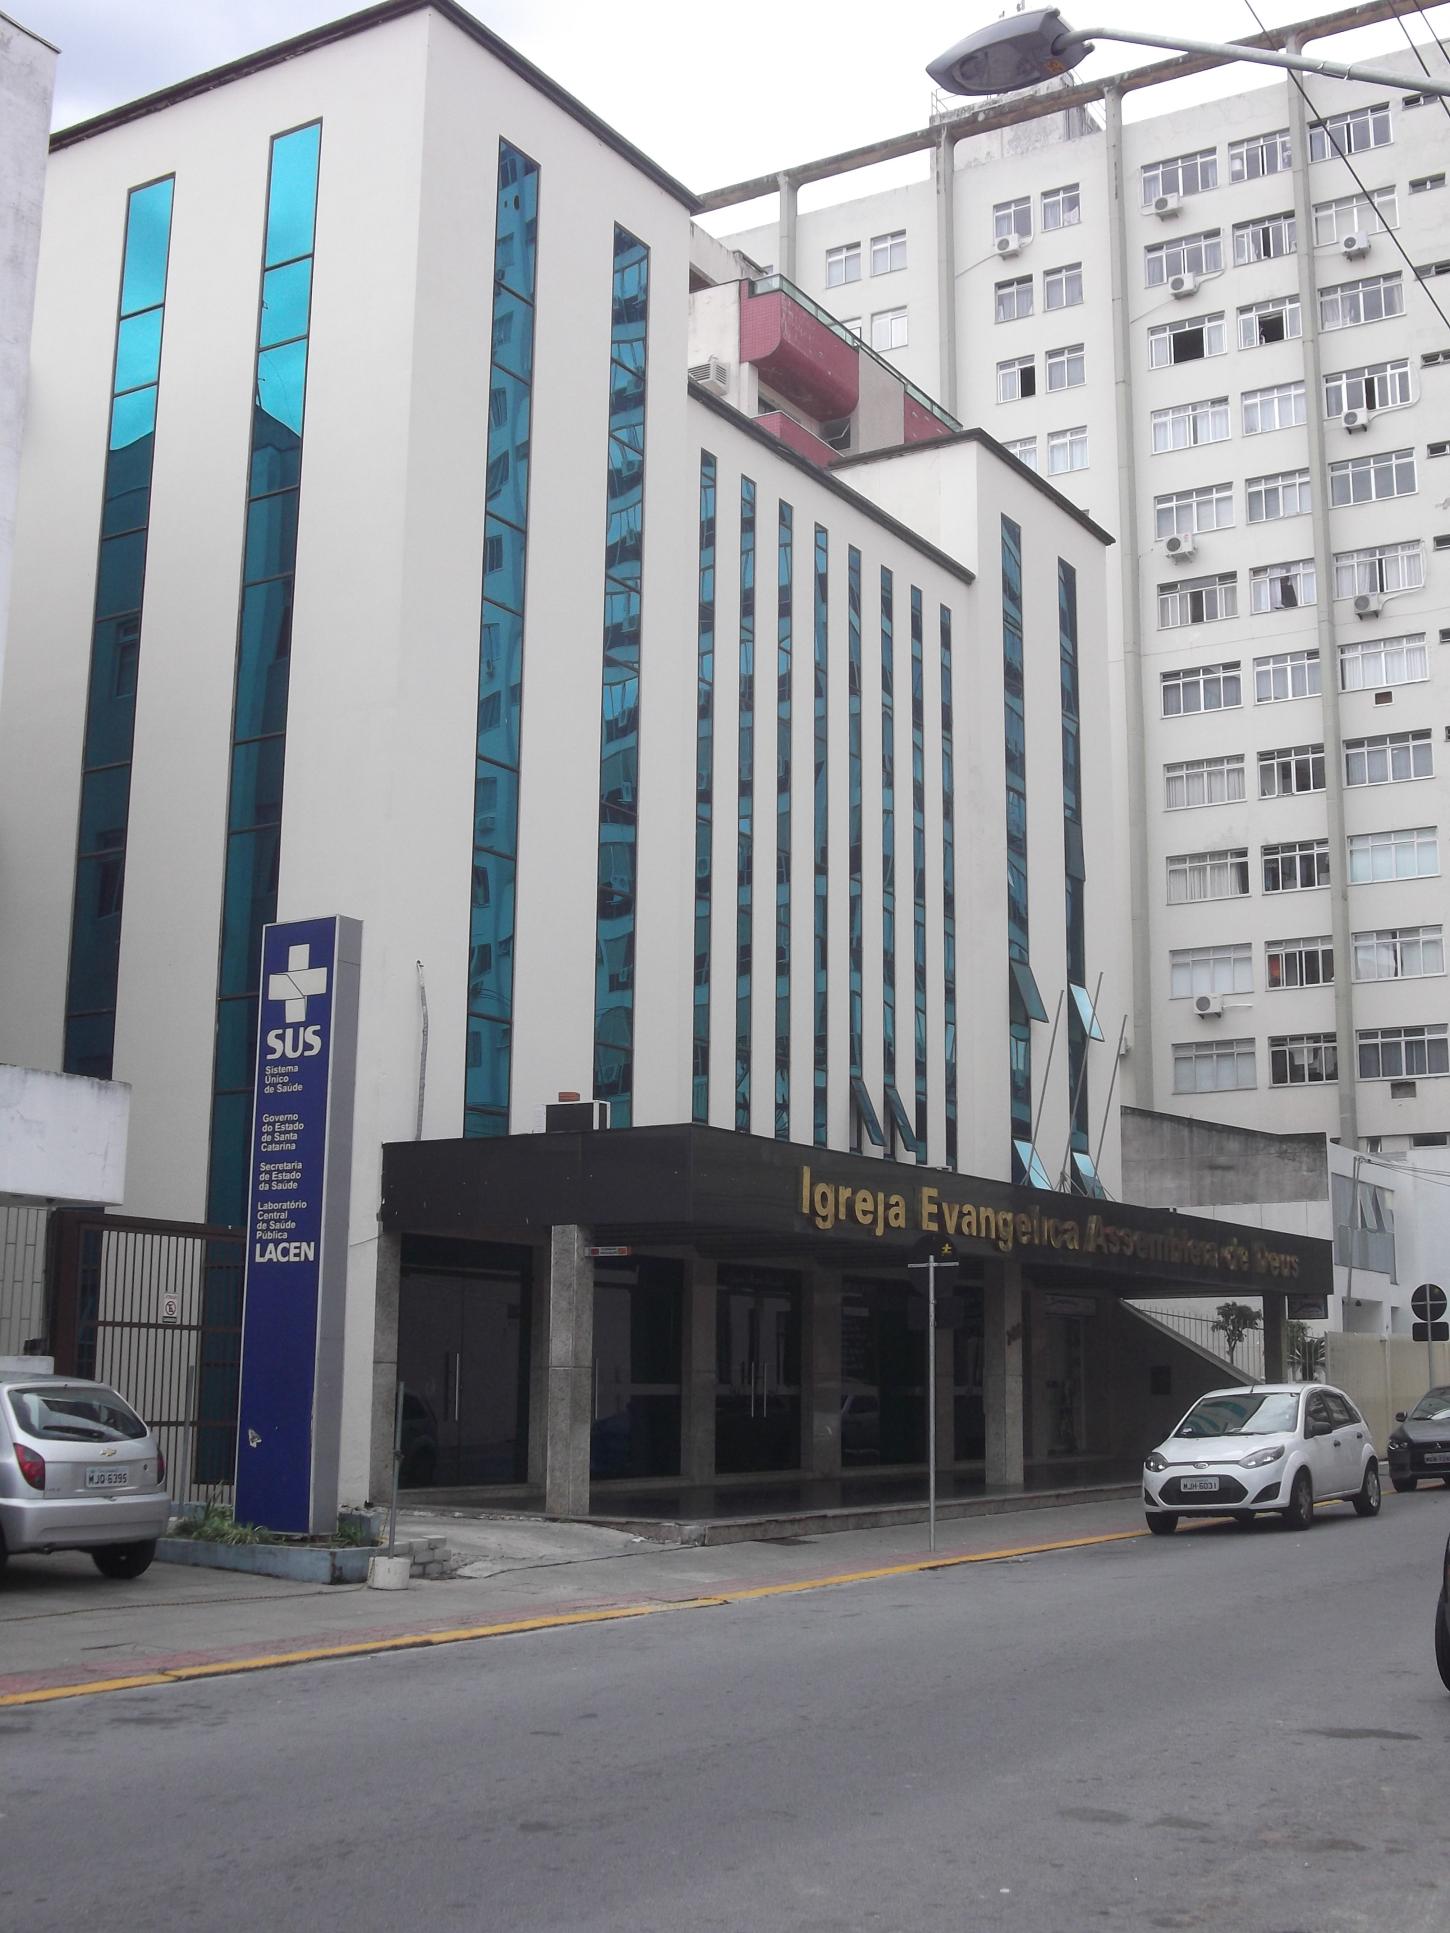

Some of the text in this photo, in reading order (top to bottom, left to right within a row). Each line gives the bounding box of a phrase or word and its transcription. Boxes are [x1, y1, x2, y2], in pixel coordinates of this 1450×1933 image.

[266, 1025, 322, 1060] SUS
[265, 1065, 299, 1075] Sistema
[264, 1082, 303, 1094] de Saúde
[262, 1113, 299, 1123] Governo
[262, 1122, 305, 1132] do Estado
[261, 1132, 298, 1142] de Santa
[261, 1142, 296, 1152] Catarina
[260, 1161, 303, 1171] Secretaria
[259, 1171, 302, 1181] de Estado
[258, 1180, 298, 1191] da Saúde
[257, 1199, 308, 1210] Laboratório
[801, 1165, 906, 1237] Igreja
[257, 1211, 288, 1220] Central
[256, 1220, 296, 1230] de Saúde
[256, 1230, 288, 1240] Pública
[255, 1241, 315, 1263] LACEN
